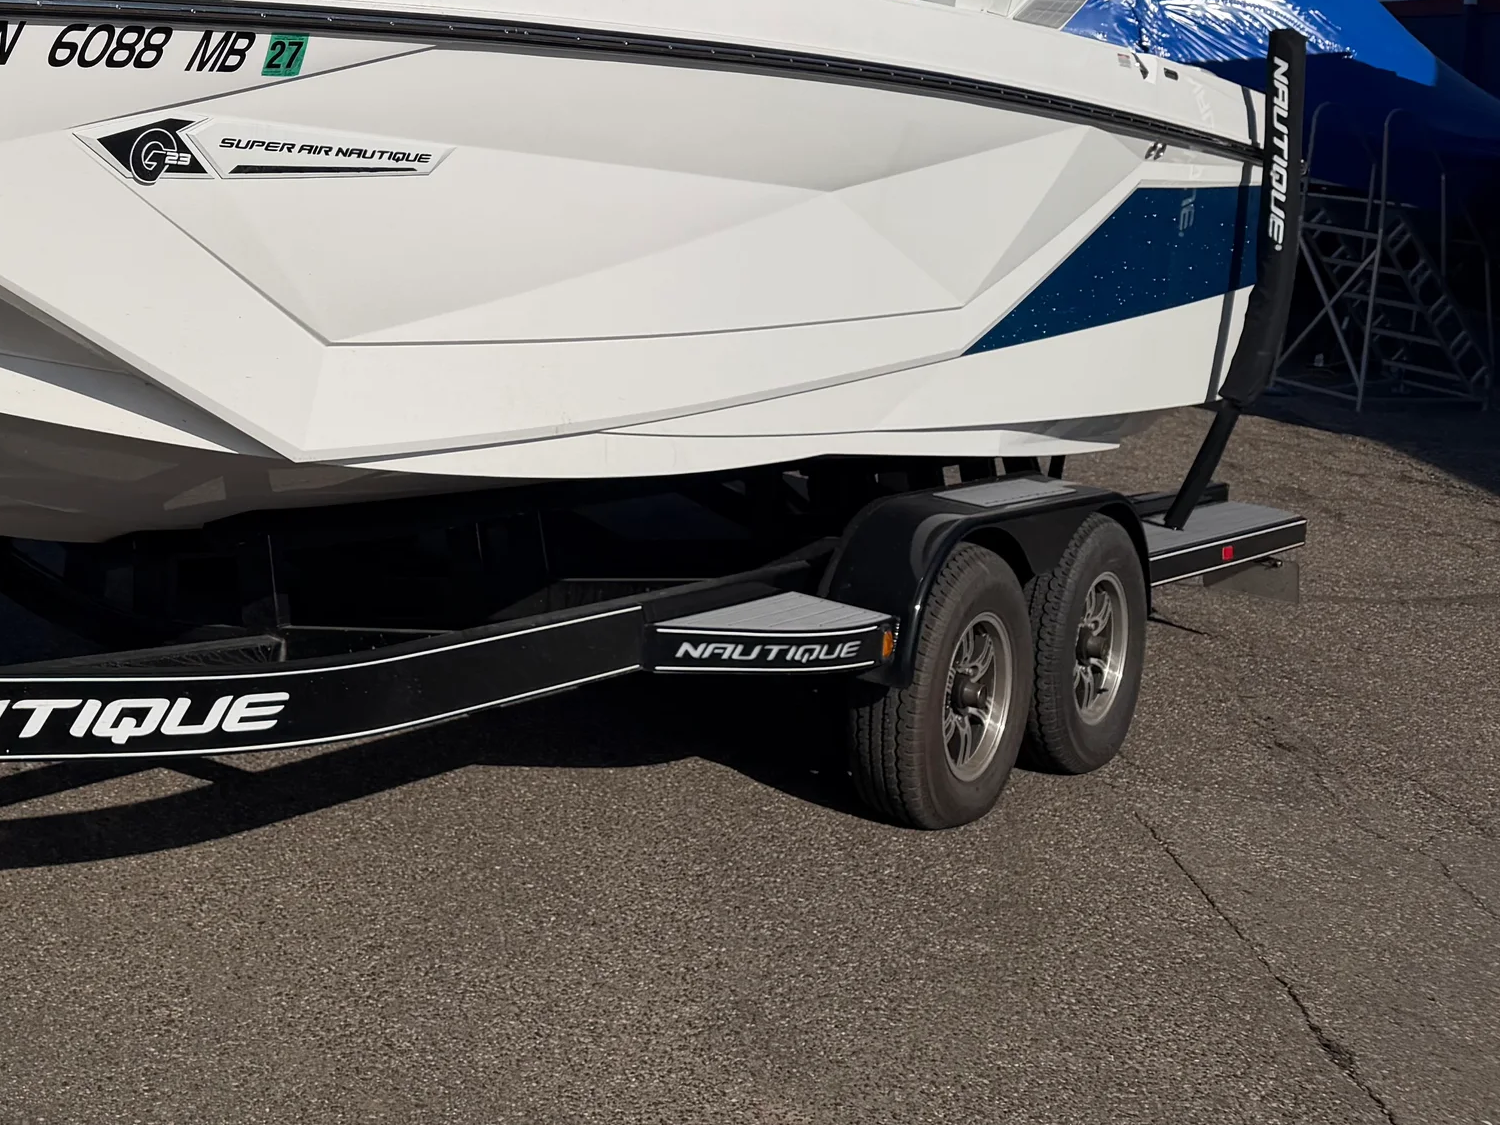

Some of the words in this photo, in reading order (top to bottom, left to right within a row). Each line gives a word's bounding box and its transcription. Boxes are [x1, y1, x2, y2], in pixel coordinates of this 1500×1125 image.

[47, 24, 173, 68] 6088
[184, 29, 256, 72] MB
[265, 40, 304, 69] 27
[219, 137, 296, 154] SUPER
[298, 143, 333, 156] AIR
[335, 146, 432, 163] NAUTIQUE
[1268, 56, 1289, 245] NAUTIQUE
[675, 640, 861, 663] NAUTIQUE
